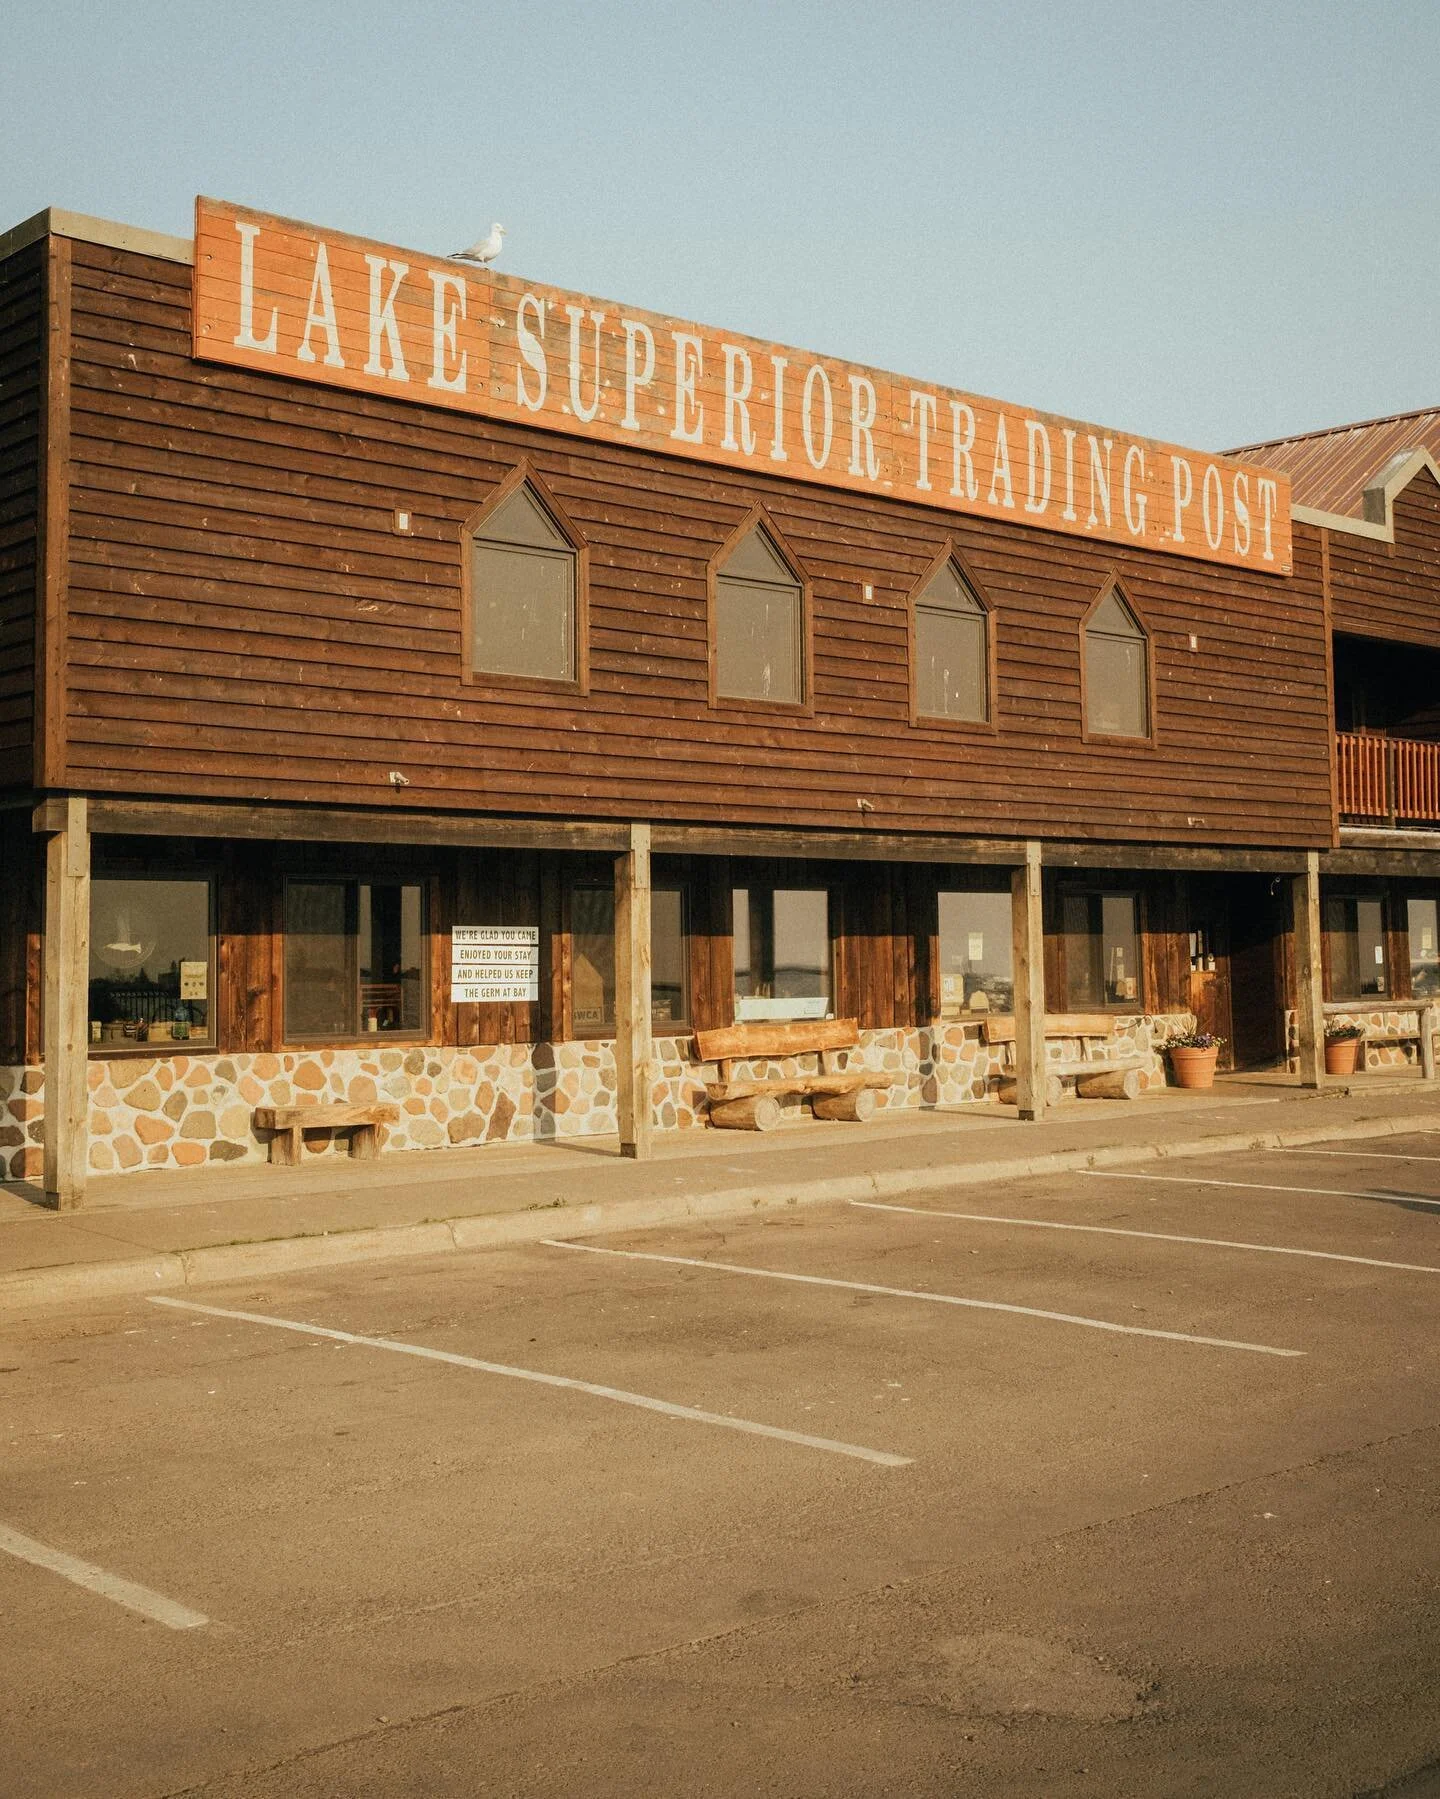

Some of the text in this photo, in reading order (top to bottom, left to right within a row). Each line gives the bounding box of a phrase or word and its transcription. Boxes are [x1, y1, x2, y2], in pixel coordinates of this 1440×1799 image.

[233, 220, 1278, 562] LAKE SUPERIOR TRADING POST
[455, 931, 536, 940] WE'RE GLAD YOU CAME
[460, 950, 532, 960] ENJOYED YOUR STAY
[458, 970, 533, 979] AND HELPED US KEEP
[465, 989, 478, 997] THE
[481, 989, 500, 997] GERM
[514, 988, 526, 996] BAY
